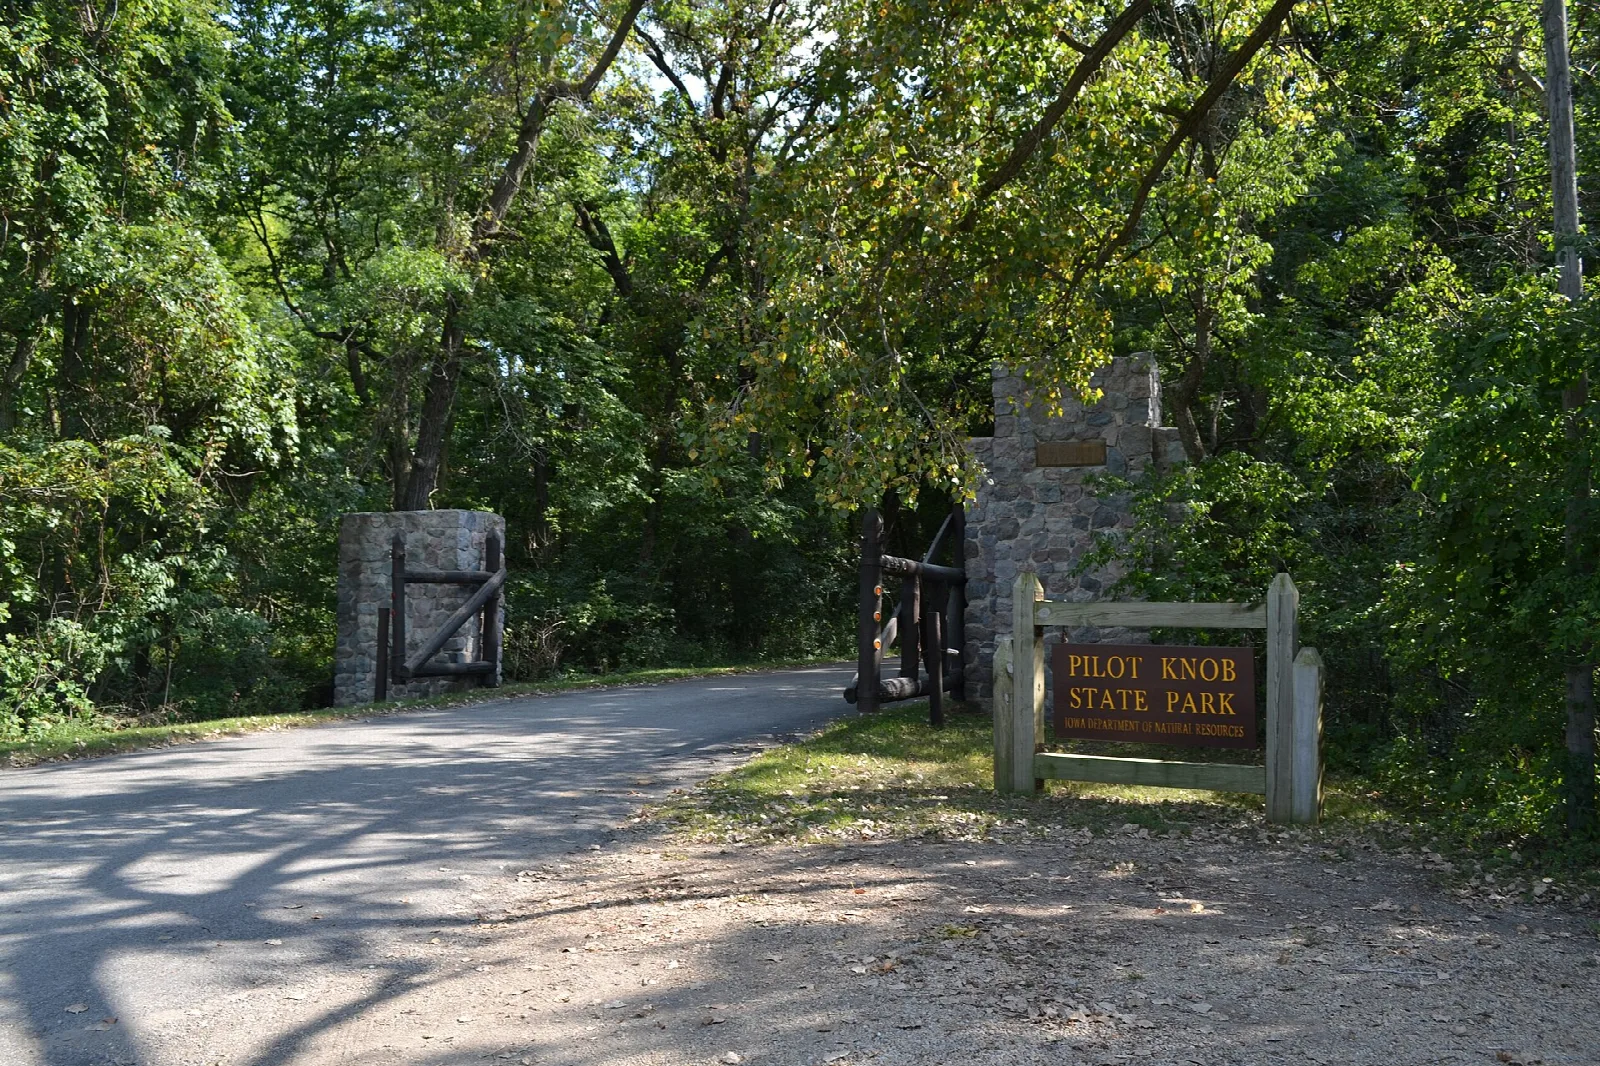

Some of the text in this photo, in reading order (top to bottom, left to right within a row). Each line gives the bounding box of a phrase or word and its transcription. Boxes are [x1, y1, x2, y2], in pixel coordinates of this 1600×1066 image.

[1068, 654, 1237, 682] PILOT KNOB
[1070, 687, 1236, 715] STATE PARK
[1064, 717, 1244, 738] IOWA DEPARTMENT OF NATURAL RESOURCES
